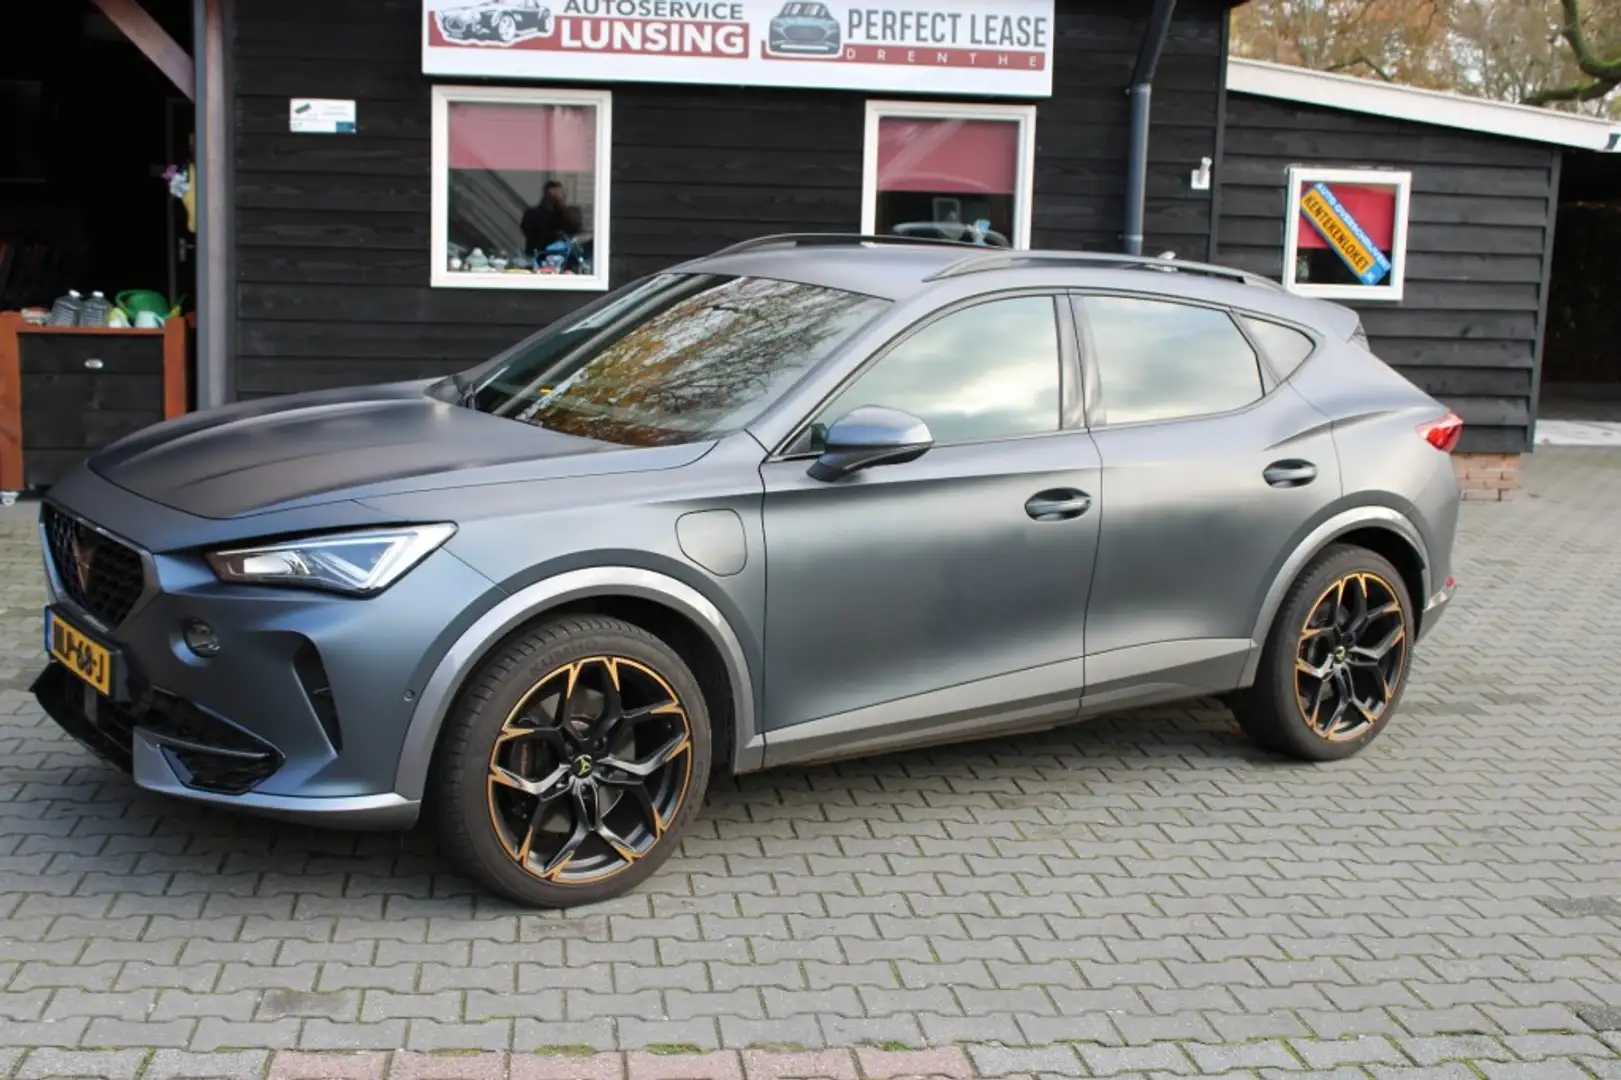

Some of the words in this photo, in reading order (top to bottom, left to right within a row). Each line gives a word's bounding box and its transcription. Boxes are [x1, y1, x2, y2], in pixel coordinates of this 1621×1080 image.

[563, 0, 743, 20] AUTOSERVICE
[561, 19, 744, 54] LUNSING
[848, 8, 962, 44] PERFECT
[970, 14, 1047, 48] LEASE
[846, 49, 1037, 67] DRENTHE
